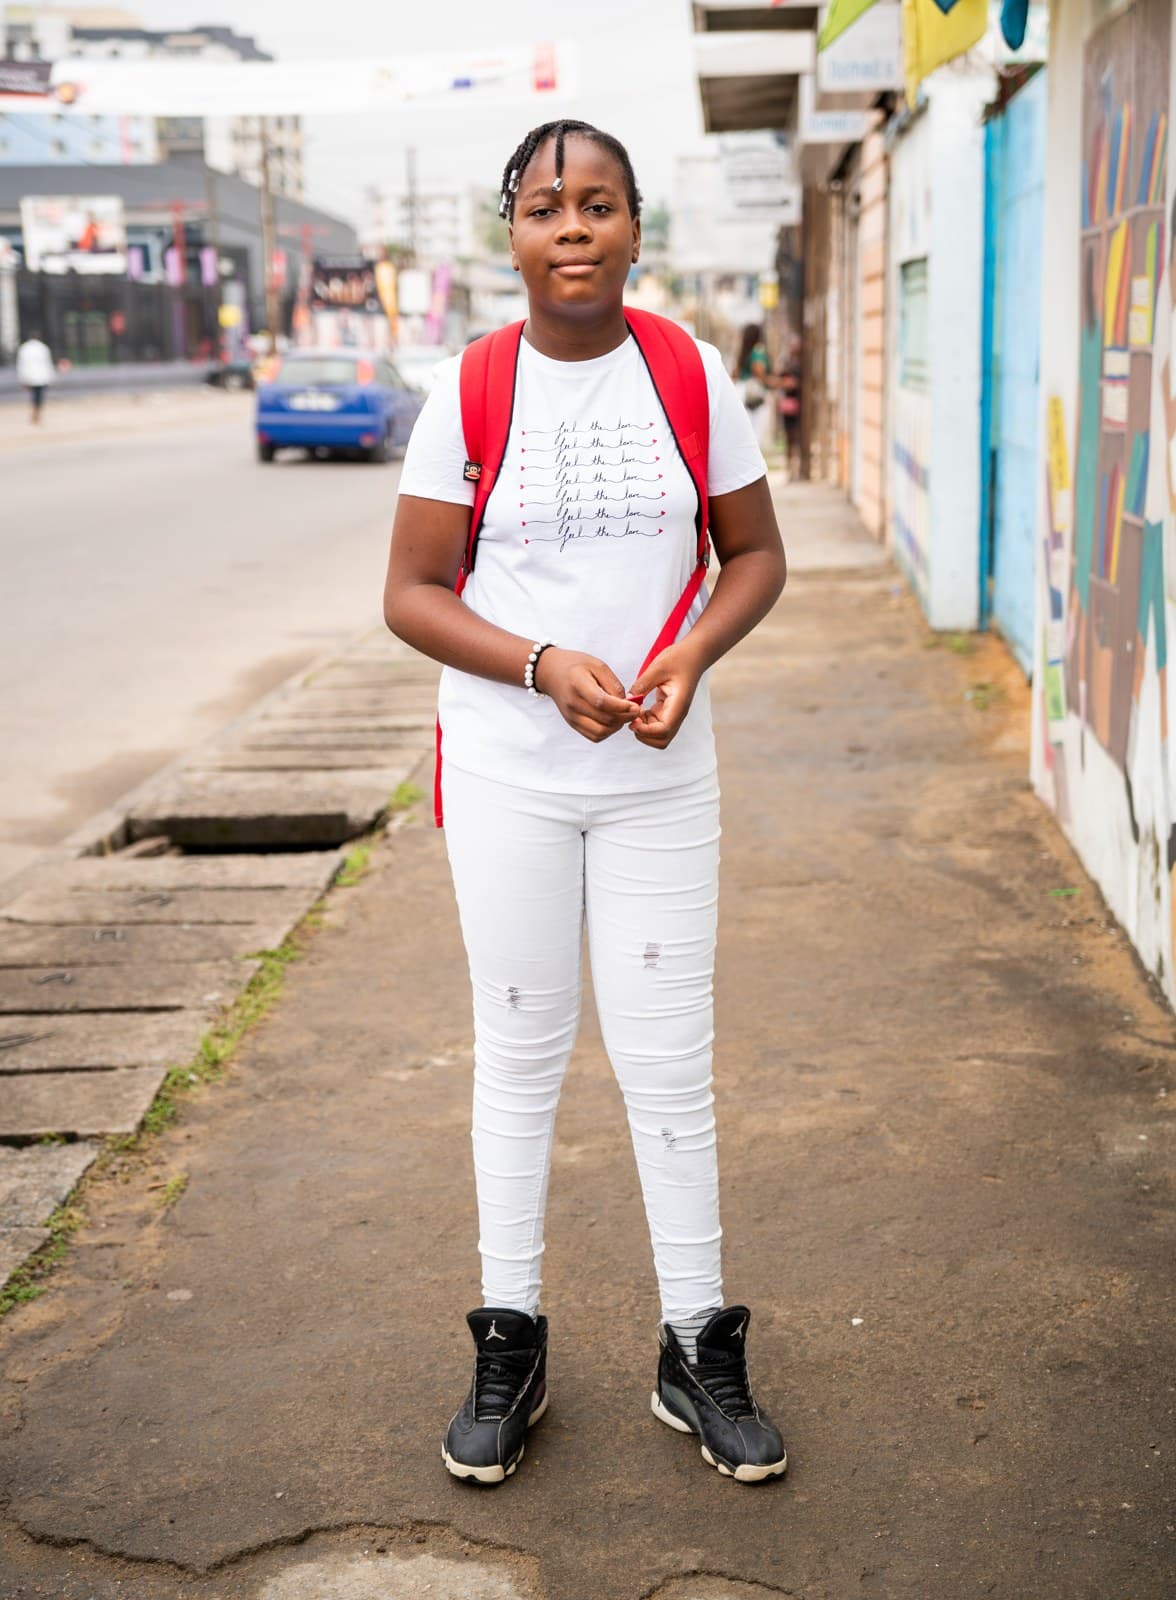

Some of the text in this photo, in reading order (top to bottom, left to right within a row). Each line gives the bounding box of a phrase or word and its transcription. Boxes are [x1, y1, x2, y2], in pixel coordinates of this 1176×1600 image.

[591, 420, 602, 430] the
[592, 437, 603, 447] the
[592, 454, 605, 464] the
[594, 472, 606, 482] the
[594, 490, 608, 500] the
[596, 507, 609, 518] the
[596, 525, 609, 536] the
